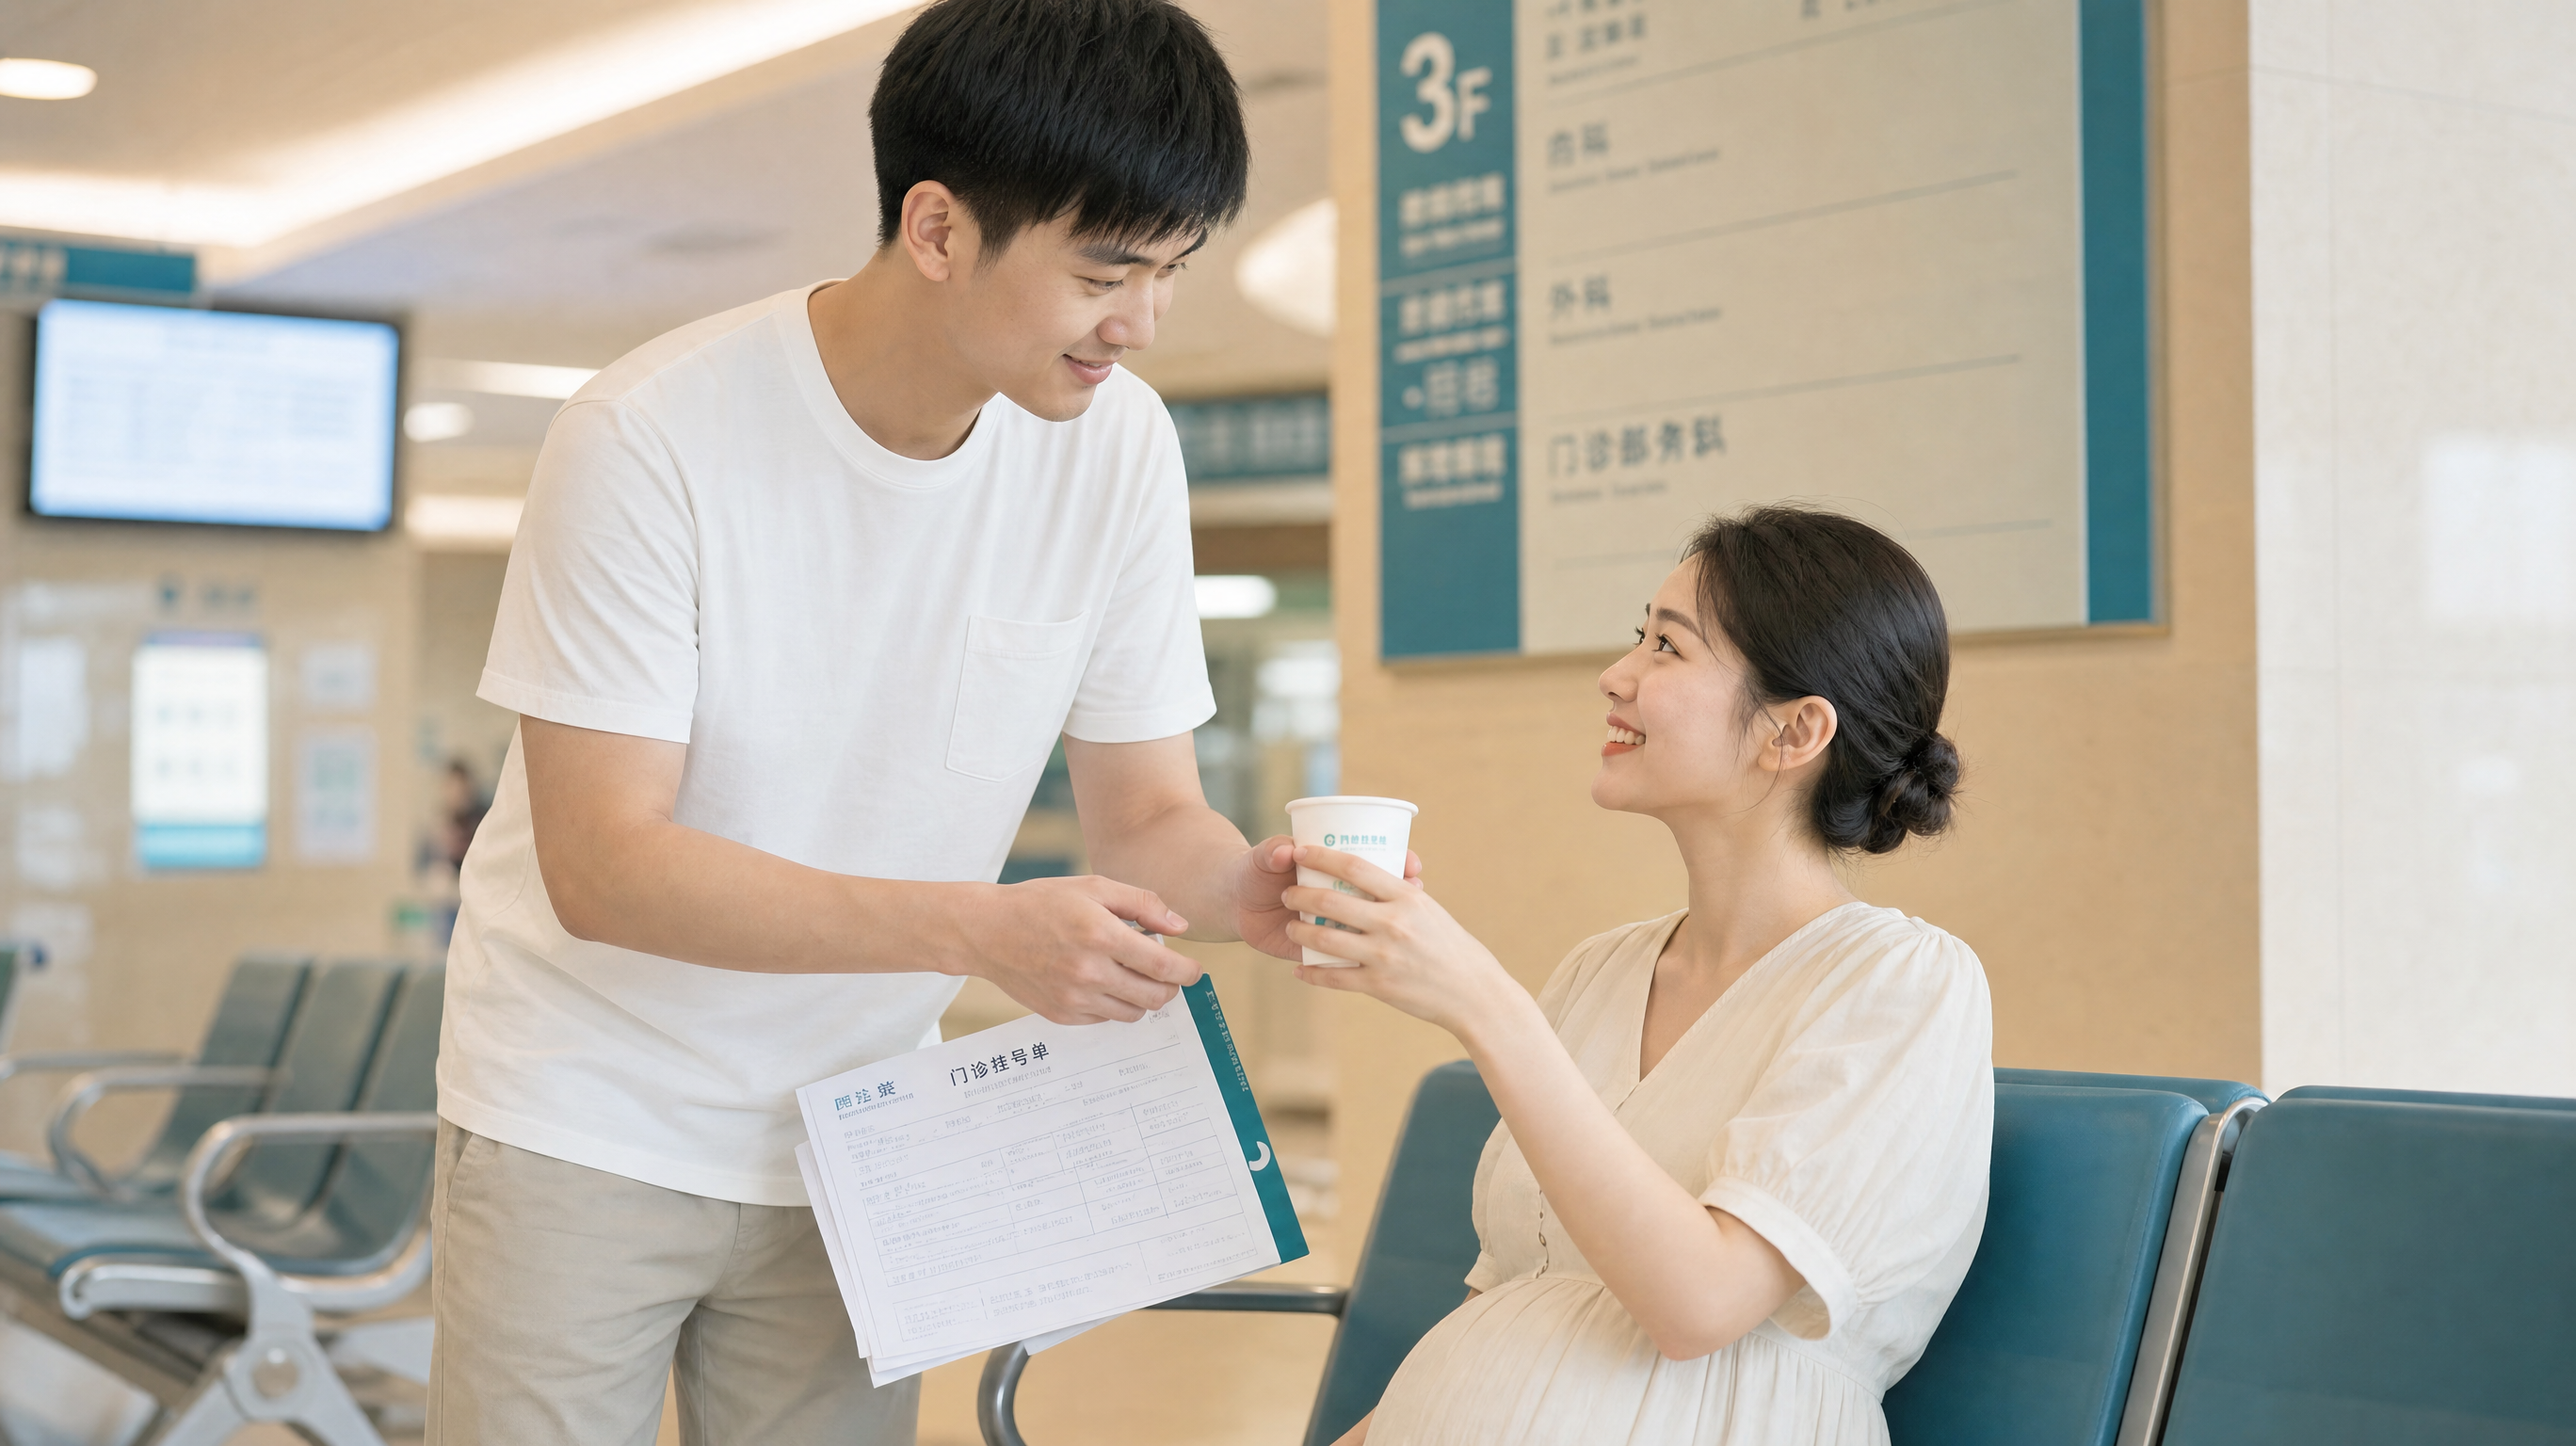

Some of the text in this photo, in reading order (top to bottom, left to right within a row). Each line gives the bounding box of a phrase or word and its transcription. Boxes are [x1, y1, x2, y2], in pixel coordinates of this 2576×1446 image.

[1400, 31, 1492, 153] 3F
[950, 1041, 1050, 1086] 门诊挂号单
